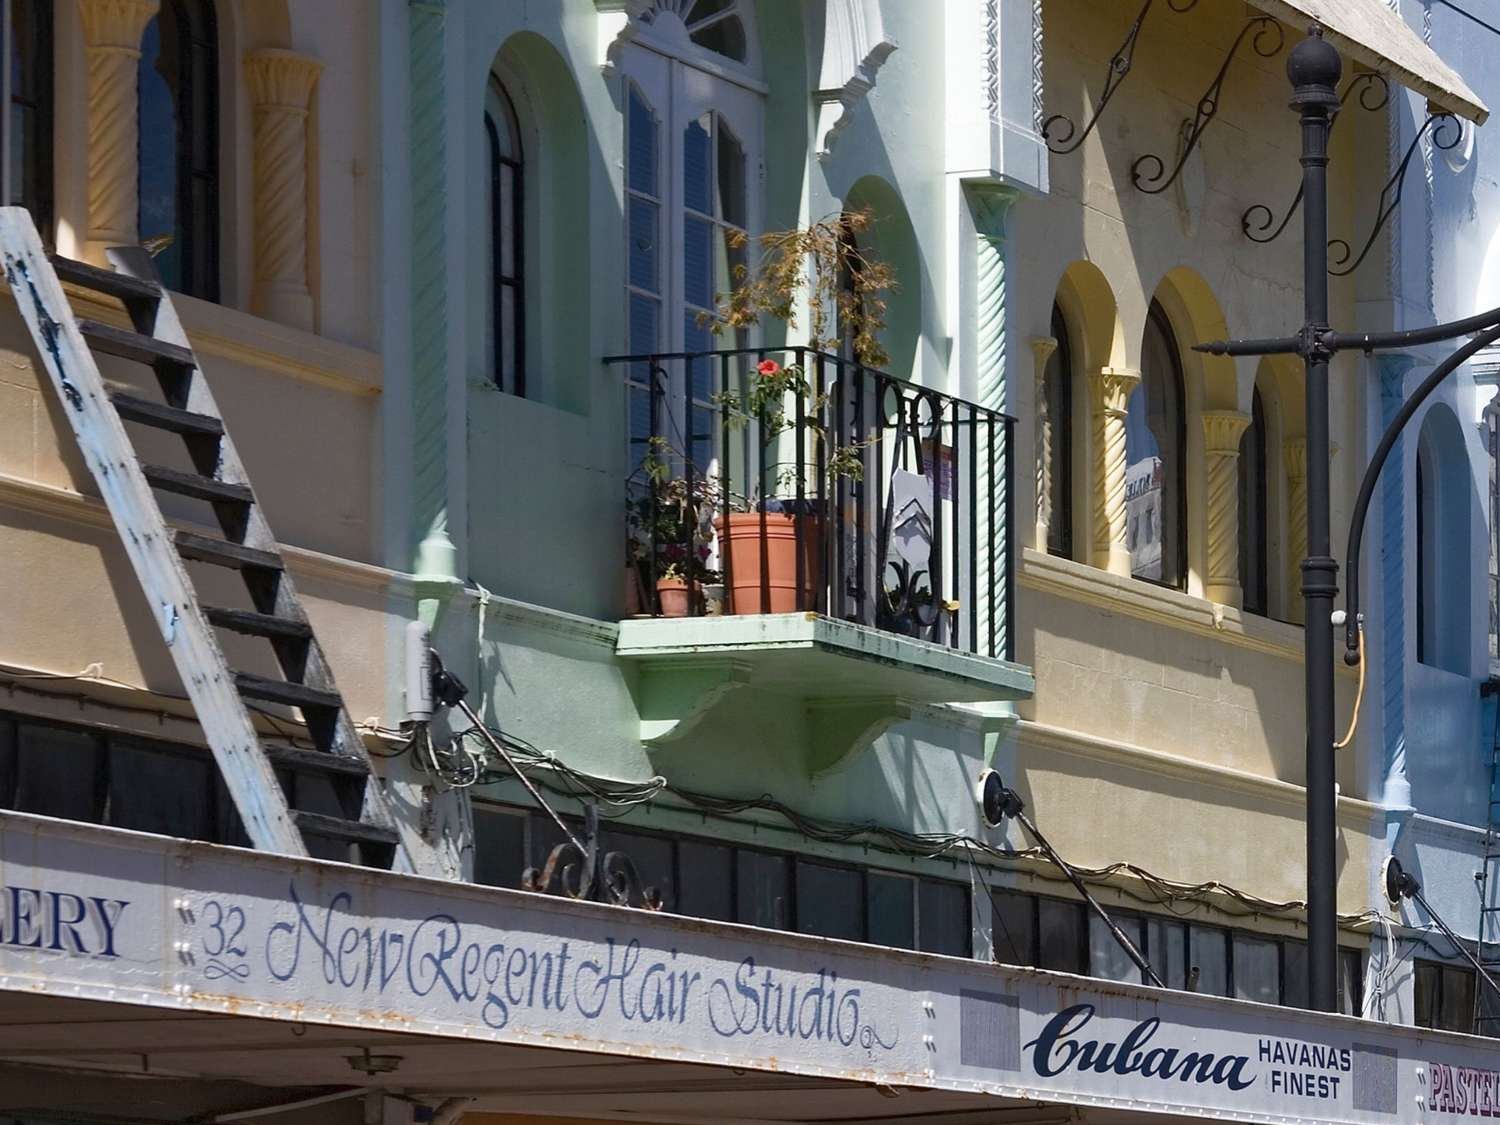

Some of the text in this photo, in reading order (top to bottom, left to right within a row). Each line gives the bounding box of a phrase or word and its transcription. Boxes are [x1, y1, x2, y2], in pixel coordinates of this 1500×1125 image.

[0, 888, 129, 957] ERY
[201, 878, 862, 1050] 32 New Regent Hair Studio
[1023, 1003, 1352, 1091] Cubana HAVANAS
[1270, 1070, 1341, 1100] FINEST
